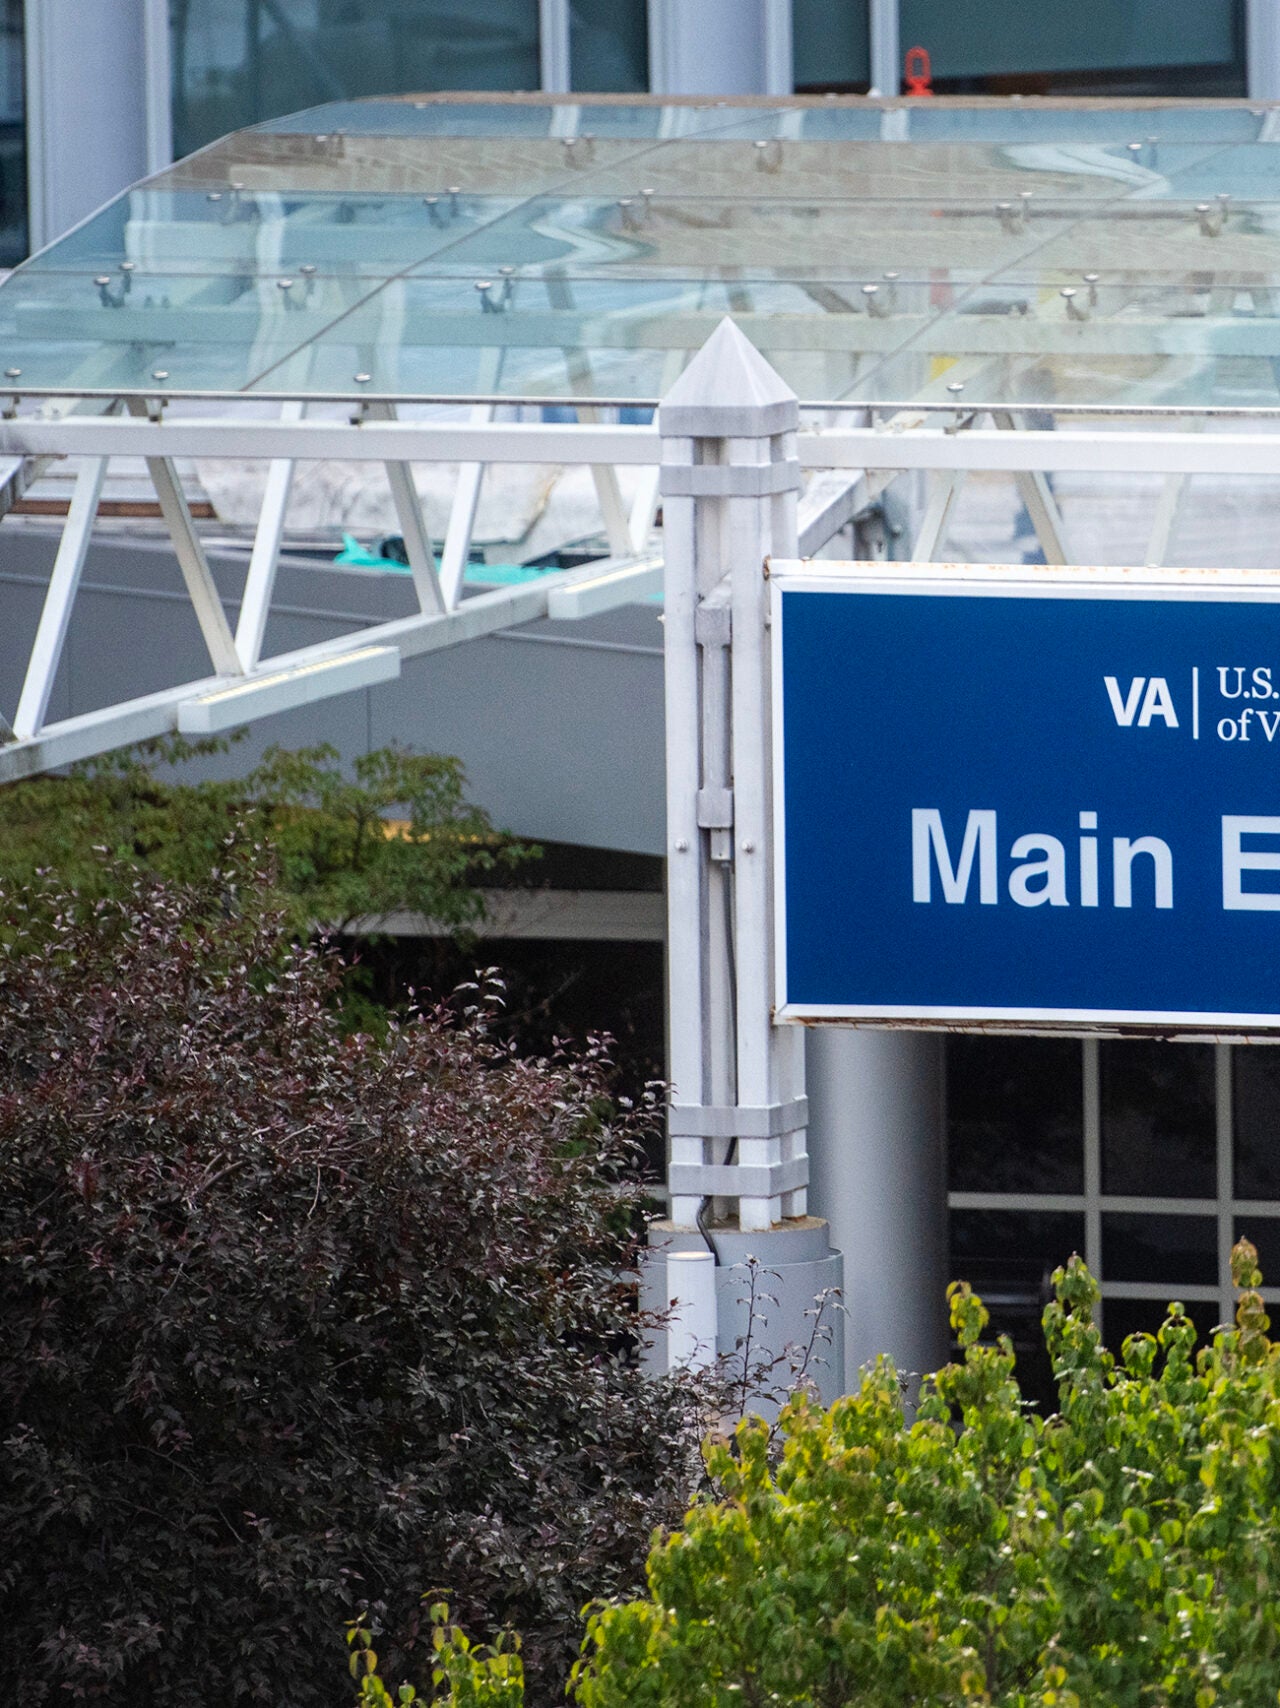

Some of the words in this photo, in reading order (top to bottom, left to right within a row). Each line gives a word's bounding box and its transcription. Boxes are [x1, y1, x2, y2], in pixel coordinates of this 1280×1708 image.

[1103, 676, 1180, 728] VA
[1216, 666, 1280, 700] U.S.
[1217, 707, 1254, 742] of
[911, 808, 1174, 909] Main
